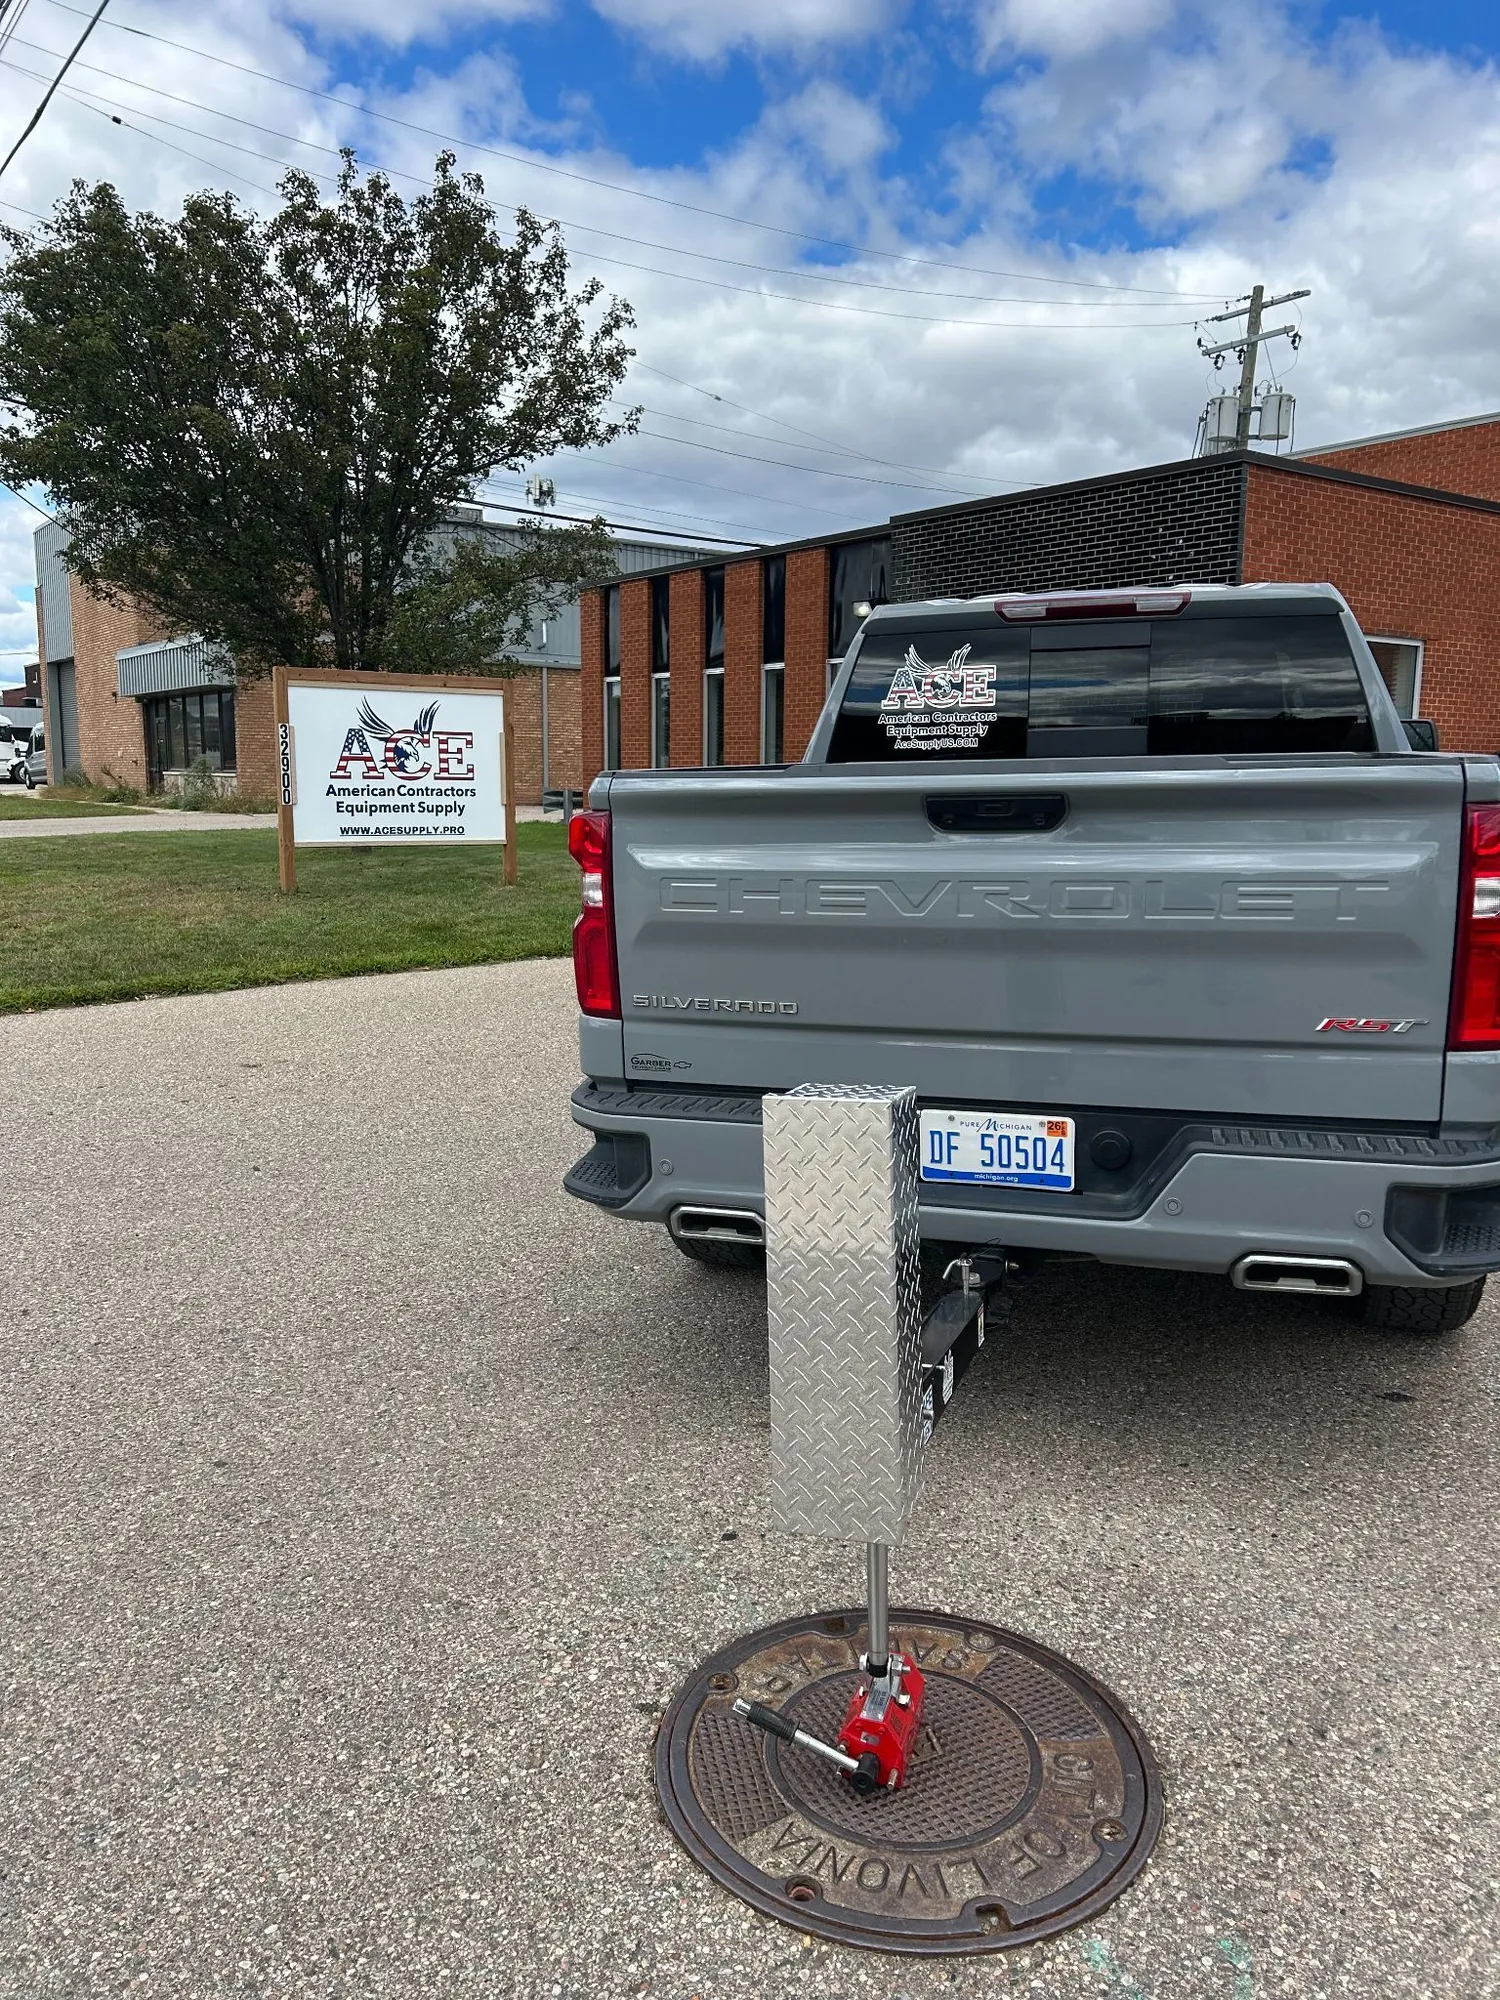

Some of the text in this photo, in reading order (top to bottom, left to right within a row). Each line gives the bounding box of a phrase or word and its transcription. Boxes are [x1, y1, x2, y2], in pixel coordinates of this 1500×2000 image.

[881, 665, 996, 709] ACE
[878, 712, 998, 724] American Contractors
[887, 723, 988, 738] Equipment Supply
[894, 738, 978, 750] AceSupplyUS.COM
[330, 728, 475, 781] ACE
[279, 724, 291, 804] 32900
[326, 784, 477, 798] American Contractors
[336, 801, 466, 817] Equipment Supply
[340, 826, 465, 835] WWW.ACESUPPLY.PRO
[660, 876, 1390, 919] CHEVROLET
[632, 994, 799, 1015] SILVERADO
[1315, 1016, 1429, 1034] RST
[631, 1056, 672, 1067] GARBER
[960, 1118, 1032, 1132] PURE MICHIGAN
[1047, 1121, 1061, 1131] 26
[929, 1130, 1065, 1173] DF 50504
[974, 1173, 1019, 1183] michigan.org
[772, 1821, 993, 1898] LIVONIA
[1009, 1828, 1068, 1882] OF
